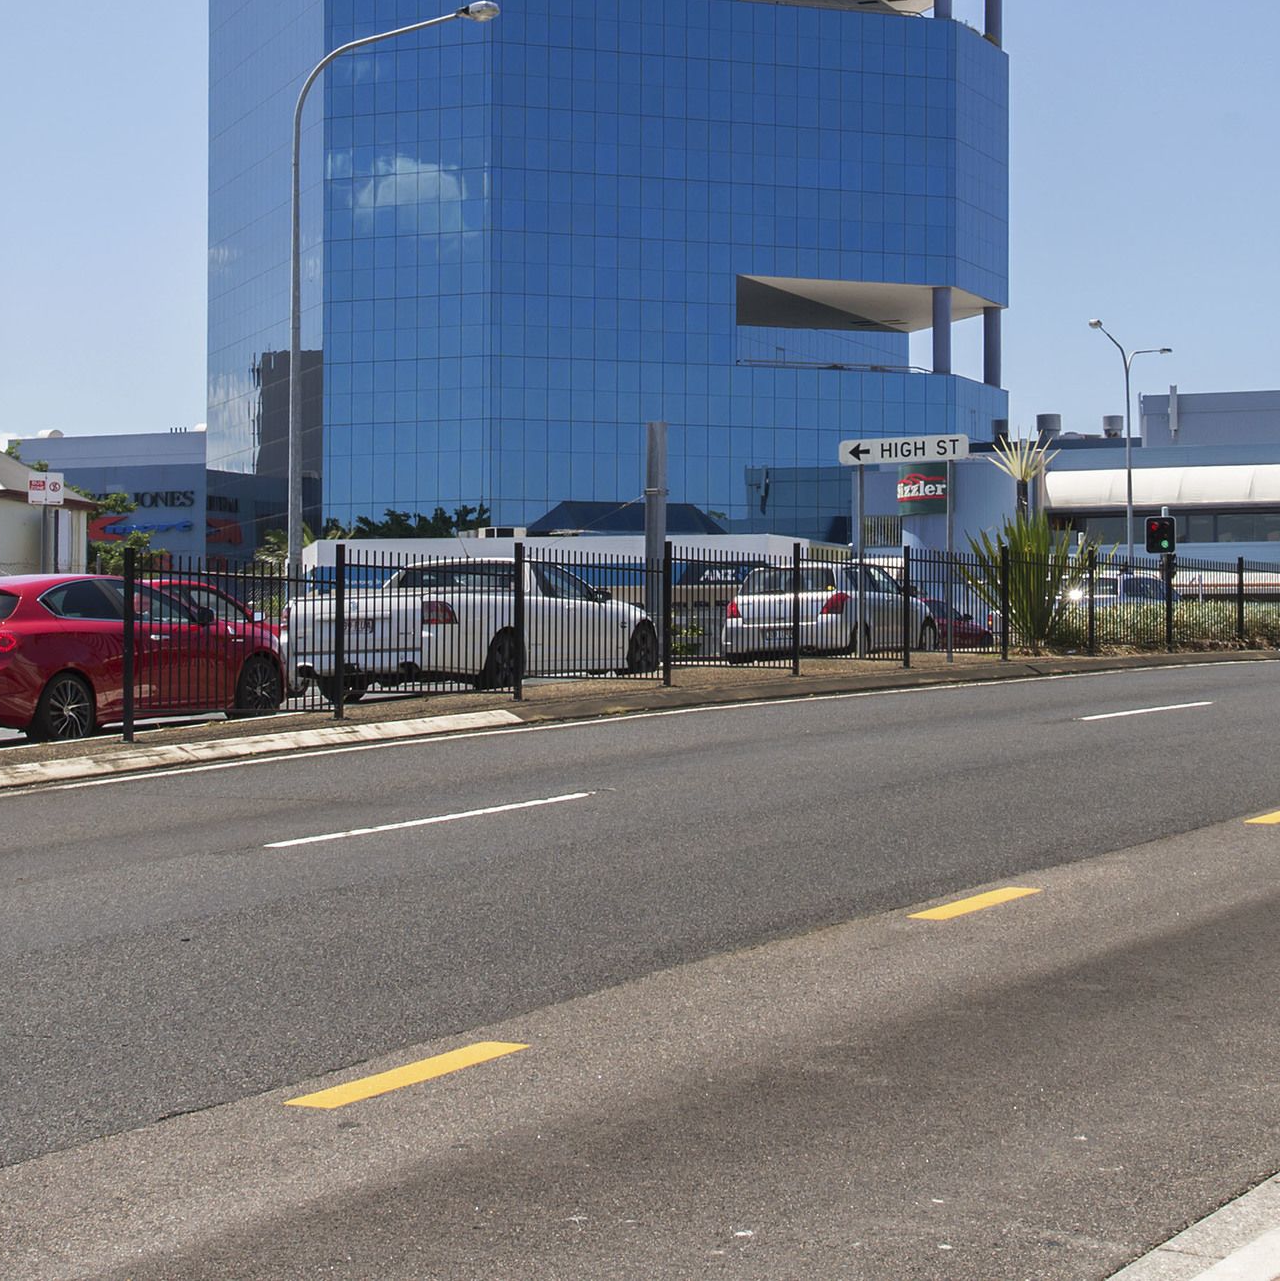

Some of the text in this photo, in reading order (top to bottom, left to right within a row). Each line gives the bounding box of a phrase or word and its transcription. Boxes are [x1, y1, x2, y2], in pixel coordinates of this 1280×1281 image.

[881, 439, 959, 458] HIGH ST
[133, 491, 194, 508] JONES
